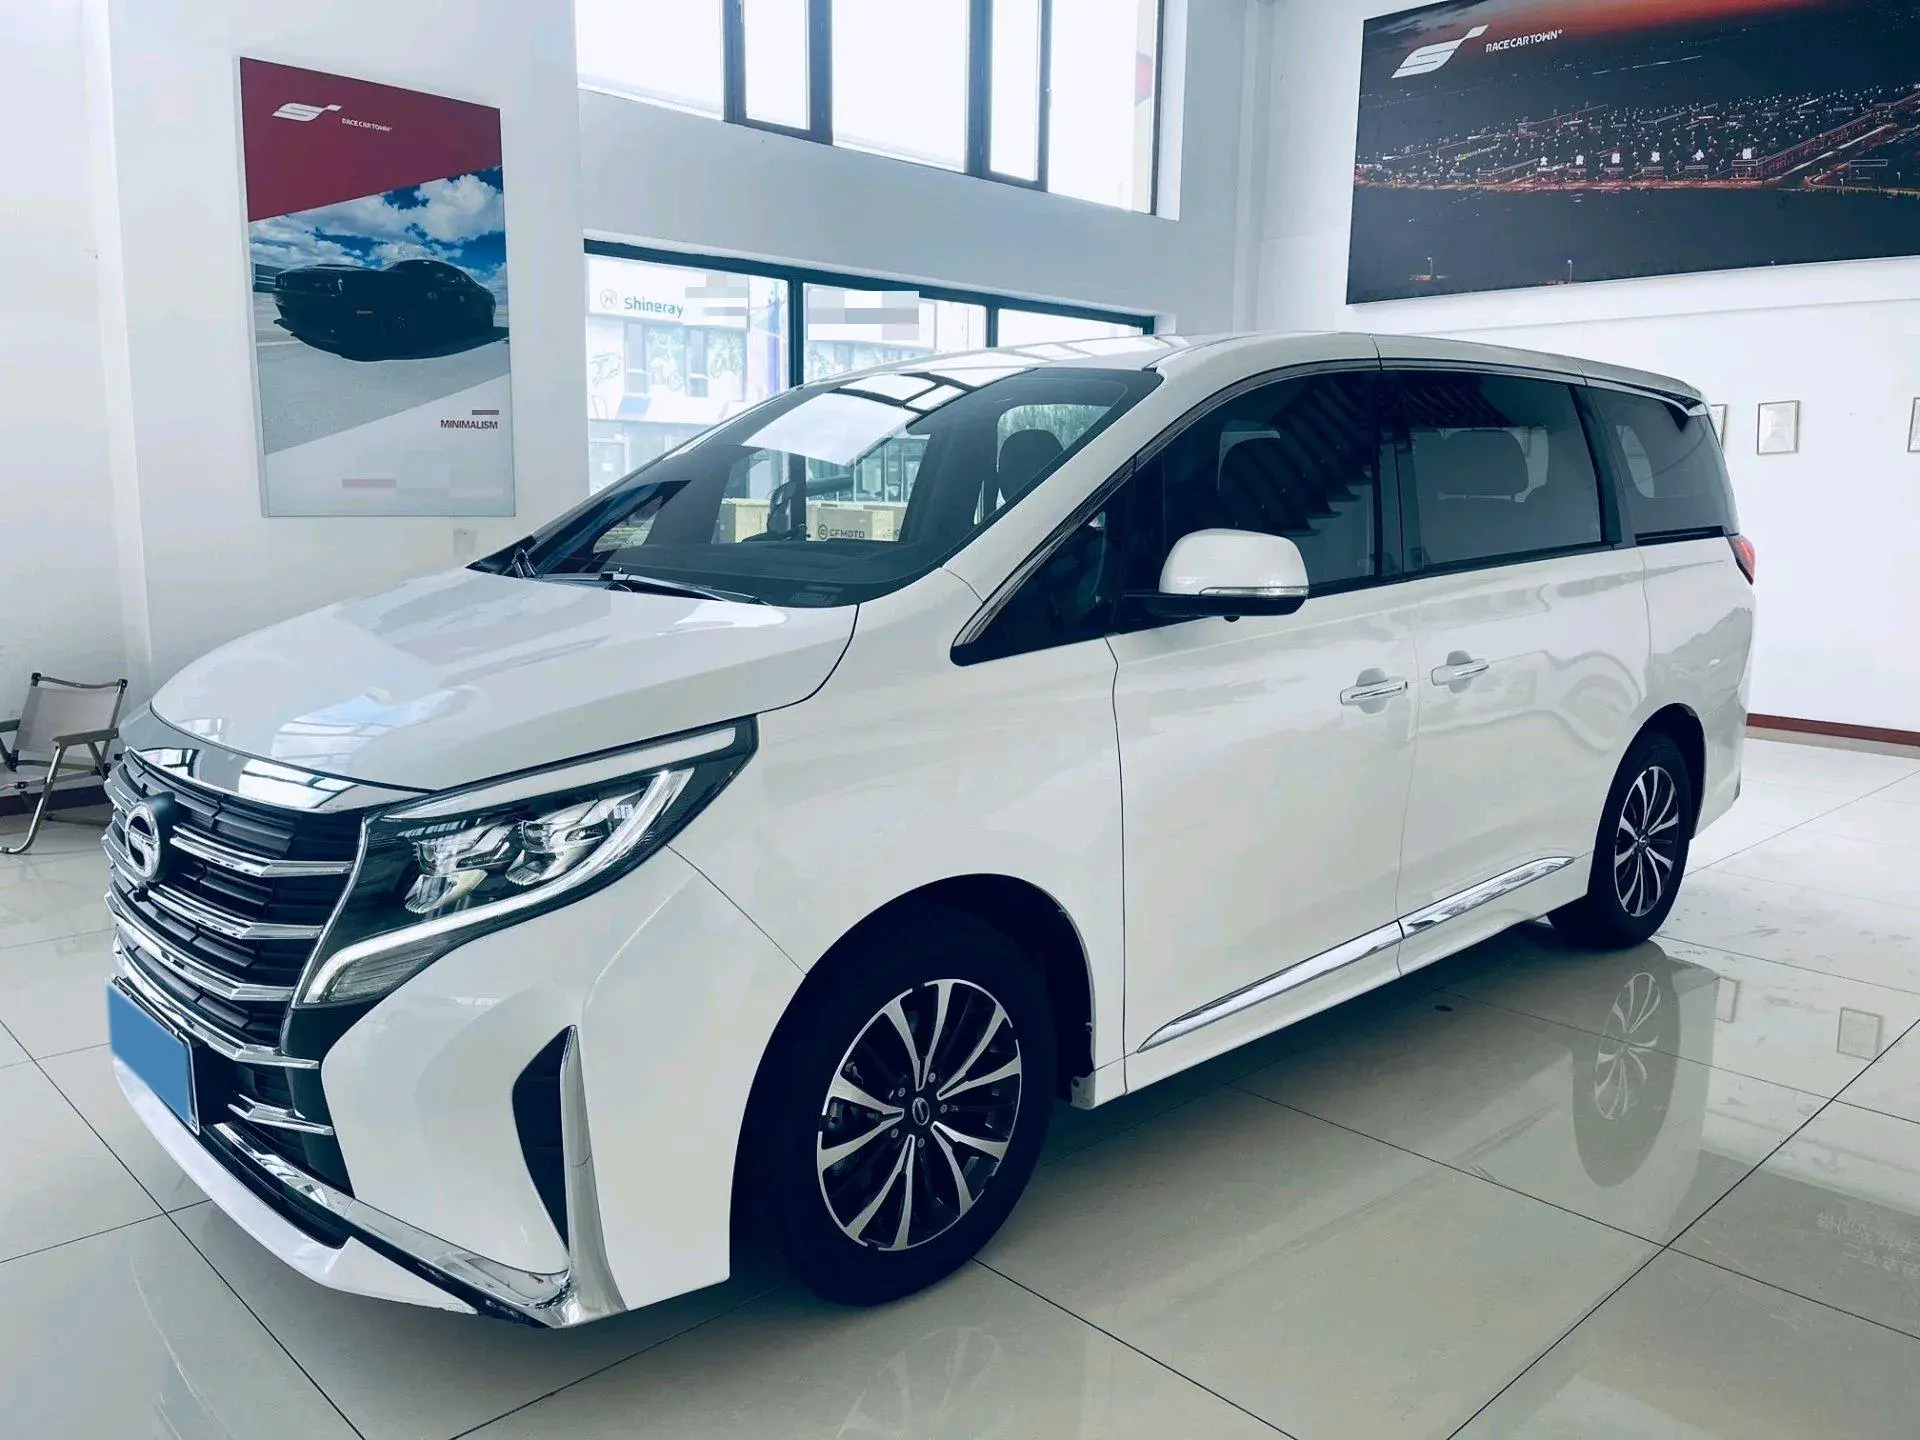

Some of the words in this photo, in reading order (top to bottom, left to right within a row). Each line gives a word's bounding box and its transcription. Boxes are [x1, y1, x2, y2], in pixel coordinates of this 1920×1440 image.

[1485, 40, 1510, 53] RACE
[341, 117, 359, 127] RACE
[624, 297, 684, 318] Shineray
[440, 419, 498, 430] MINIMALISM
[829, 529, 866, 539] CFMOTO
